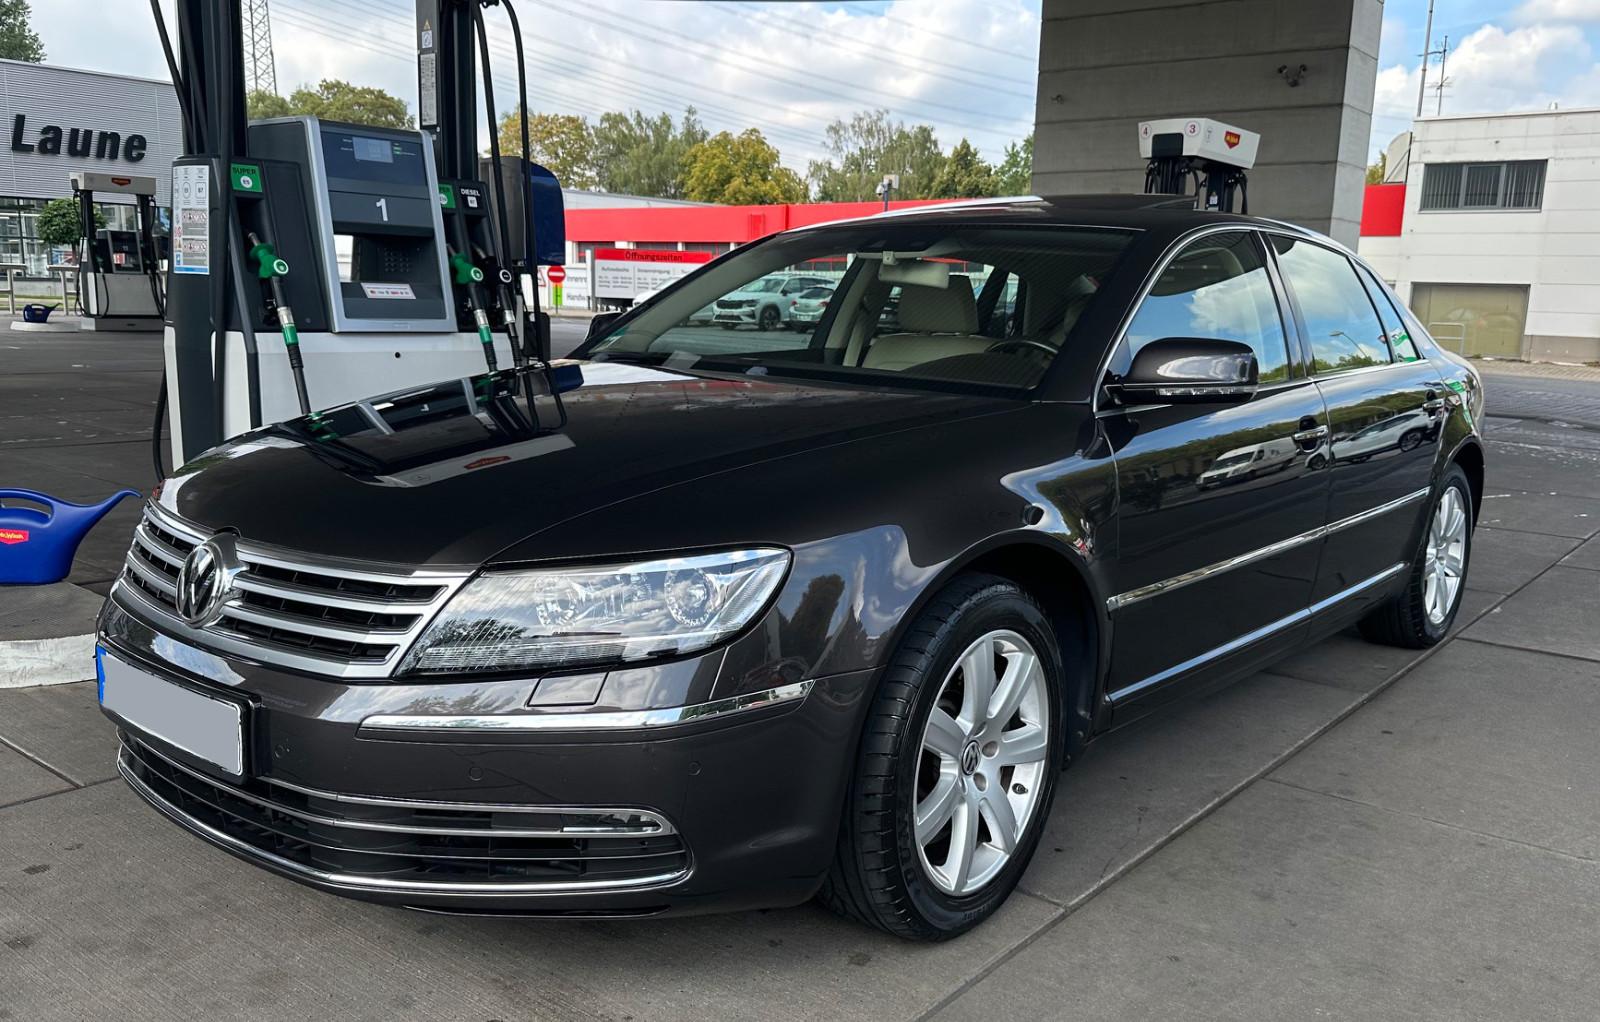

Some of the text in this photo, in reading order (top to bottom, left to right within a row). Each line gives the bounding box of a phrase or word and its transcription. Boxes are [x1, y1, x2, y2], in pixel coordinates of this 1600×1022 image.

[1143, 127, 1148, 136] 4
[1189, 124, 1196, 134] 3
[11, 113, 147, 162] Laune
[232, 167, 256, 175] SUPER
[460, 188, 481, 197] DIESEL
[375, 198, 389, 222] 1
[625, 250, 683, 262] Öffnungszeiten
